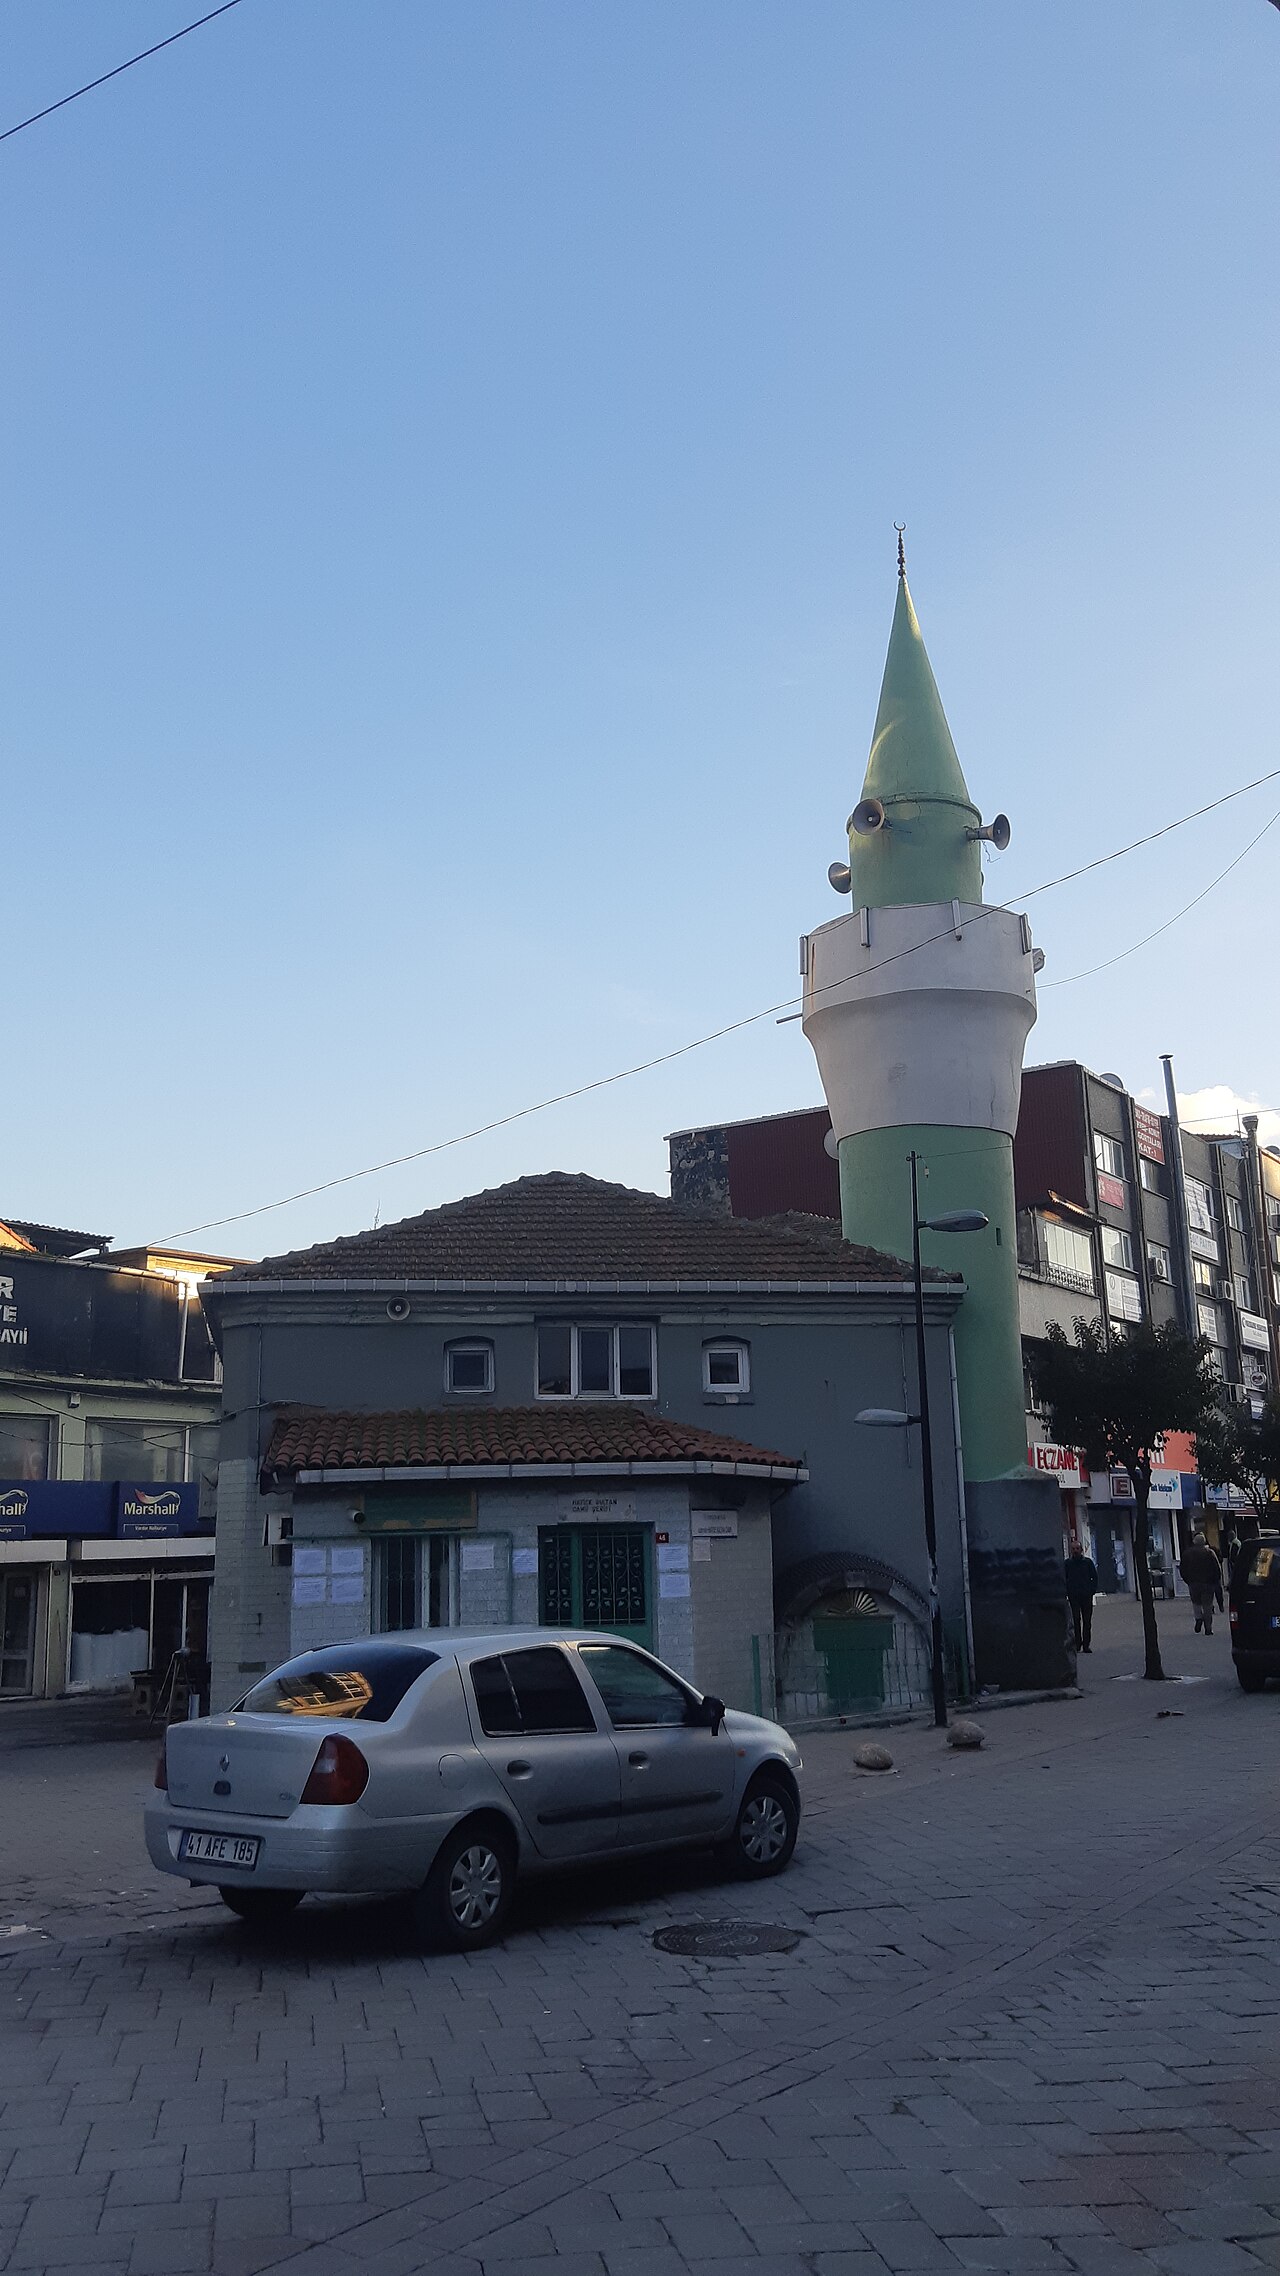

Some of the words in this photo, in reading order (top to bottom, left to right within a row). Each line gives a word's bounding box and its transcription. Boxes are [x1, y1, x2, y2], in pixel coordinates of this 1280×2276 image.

[1036, 1446, 1078, 1471] ECZANE
[124, 1502, 175, 1516] Marshall
[188, 1835, 203, 1855] 41
[205, 1836, 228, 1859] AFE
[233, 1839, 255, 1862] 185
